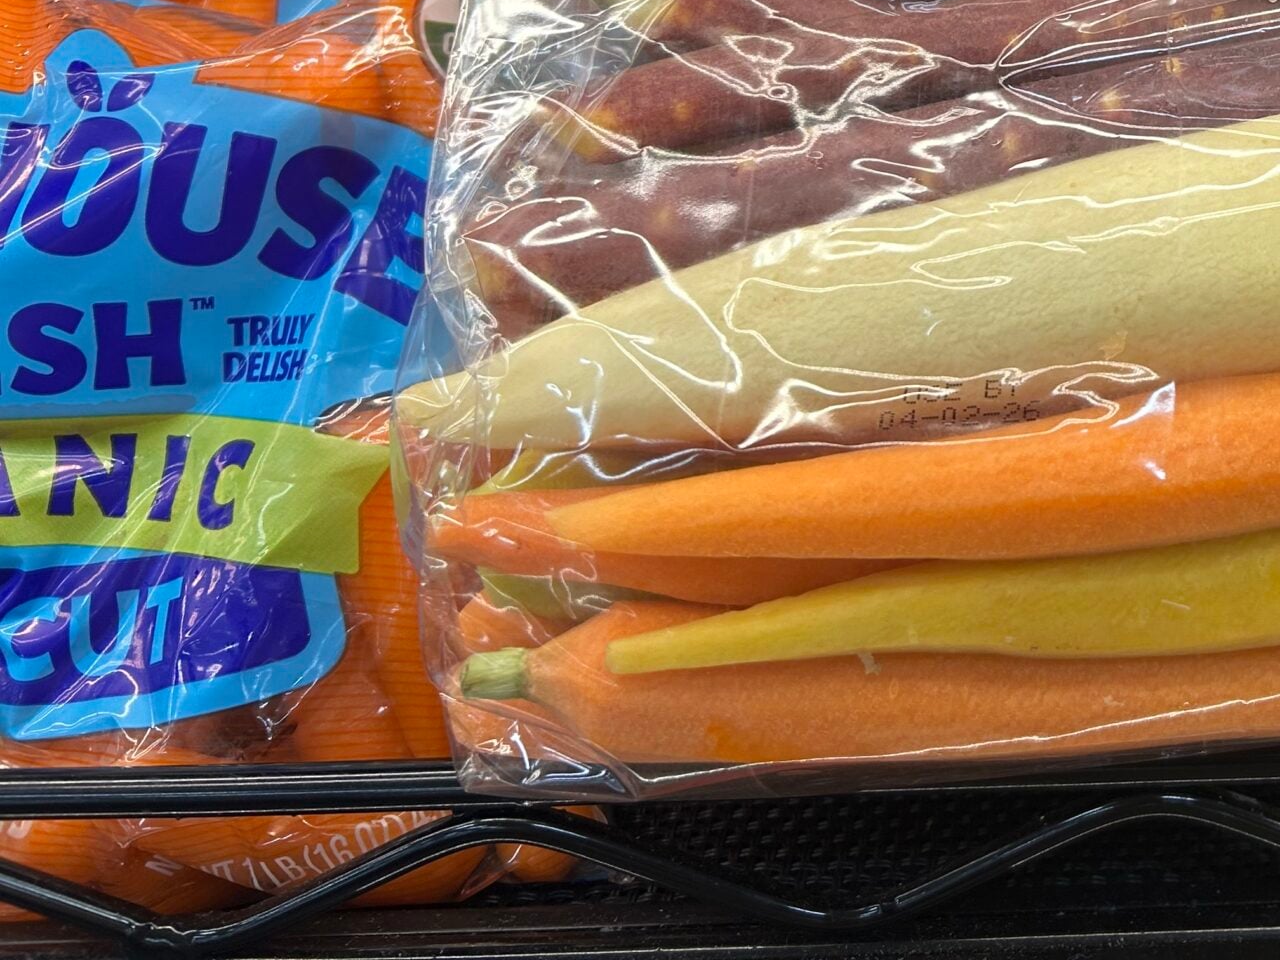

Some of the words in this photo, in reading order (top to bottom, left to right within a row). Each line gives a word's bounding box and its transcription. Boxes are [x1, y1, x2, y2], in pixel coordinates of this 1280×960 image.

[226, 313, 316, 346] TRULY
[222, 349, 308, 383] DELISH
[878, 400, 1041, 430] 04-02-26
[260, 855, 304, 889] LB
